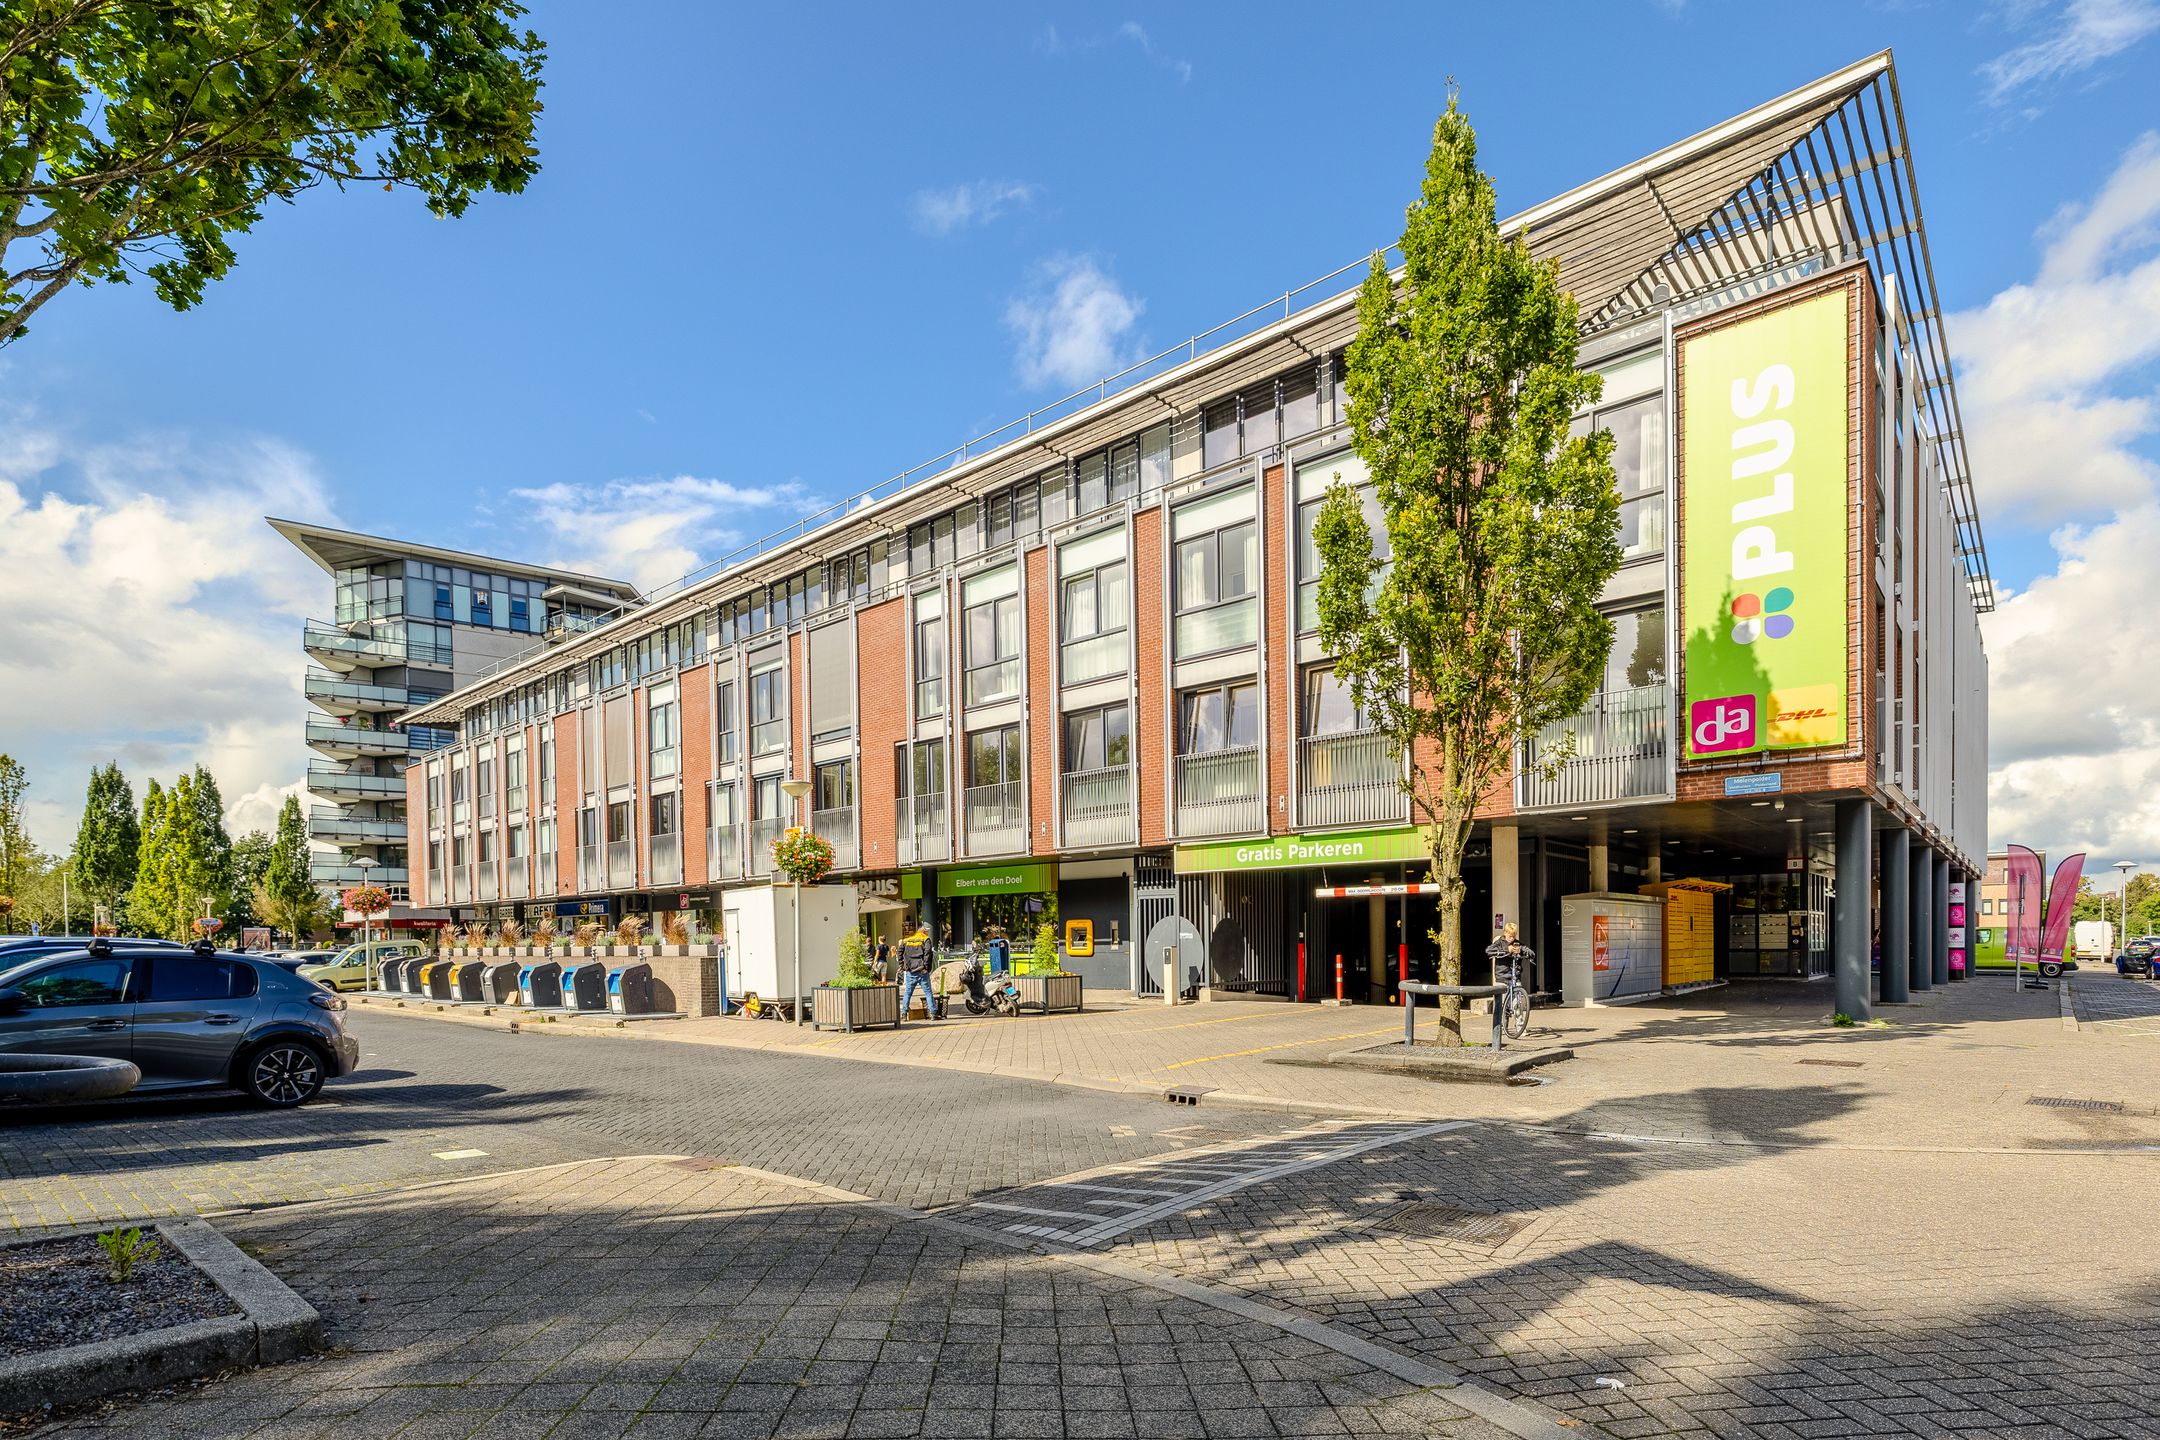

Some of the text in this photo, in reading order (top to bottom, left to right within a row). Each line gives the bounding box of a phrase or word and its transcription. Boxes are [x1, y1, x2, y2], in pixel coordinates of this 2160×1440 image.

[1731, 364, 1795, 581] PLUS
[1776, 708, 1827, 722] DHL
[1695, 705, 1750, 746] da
[1236, 841, 1363, 863] Gratis Parkeren
[859, 878, 899, 895] PLUS
[955, 874, 1023, 888] Elbert van den Doel
[588, 902, 605, 914] Primera
